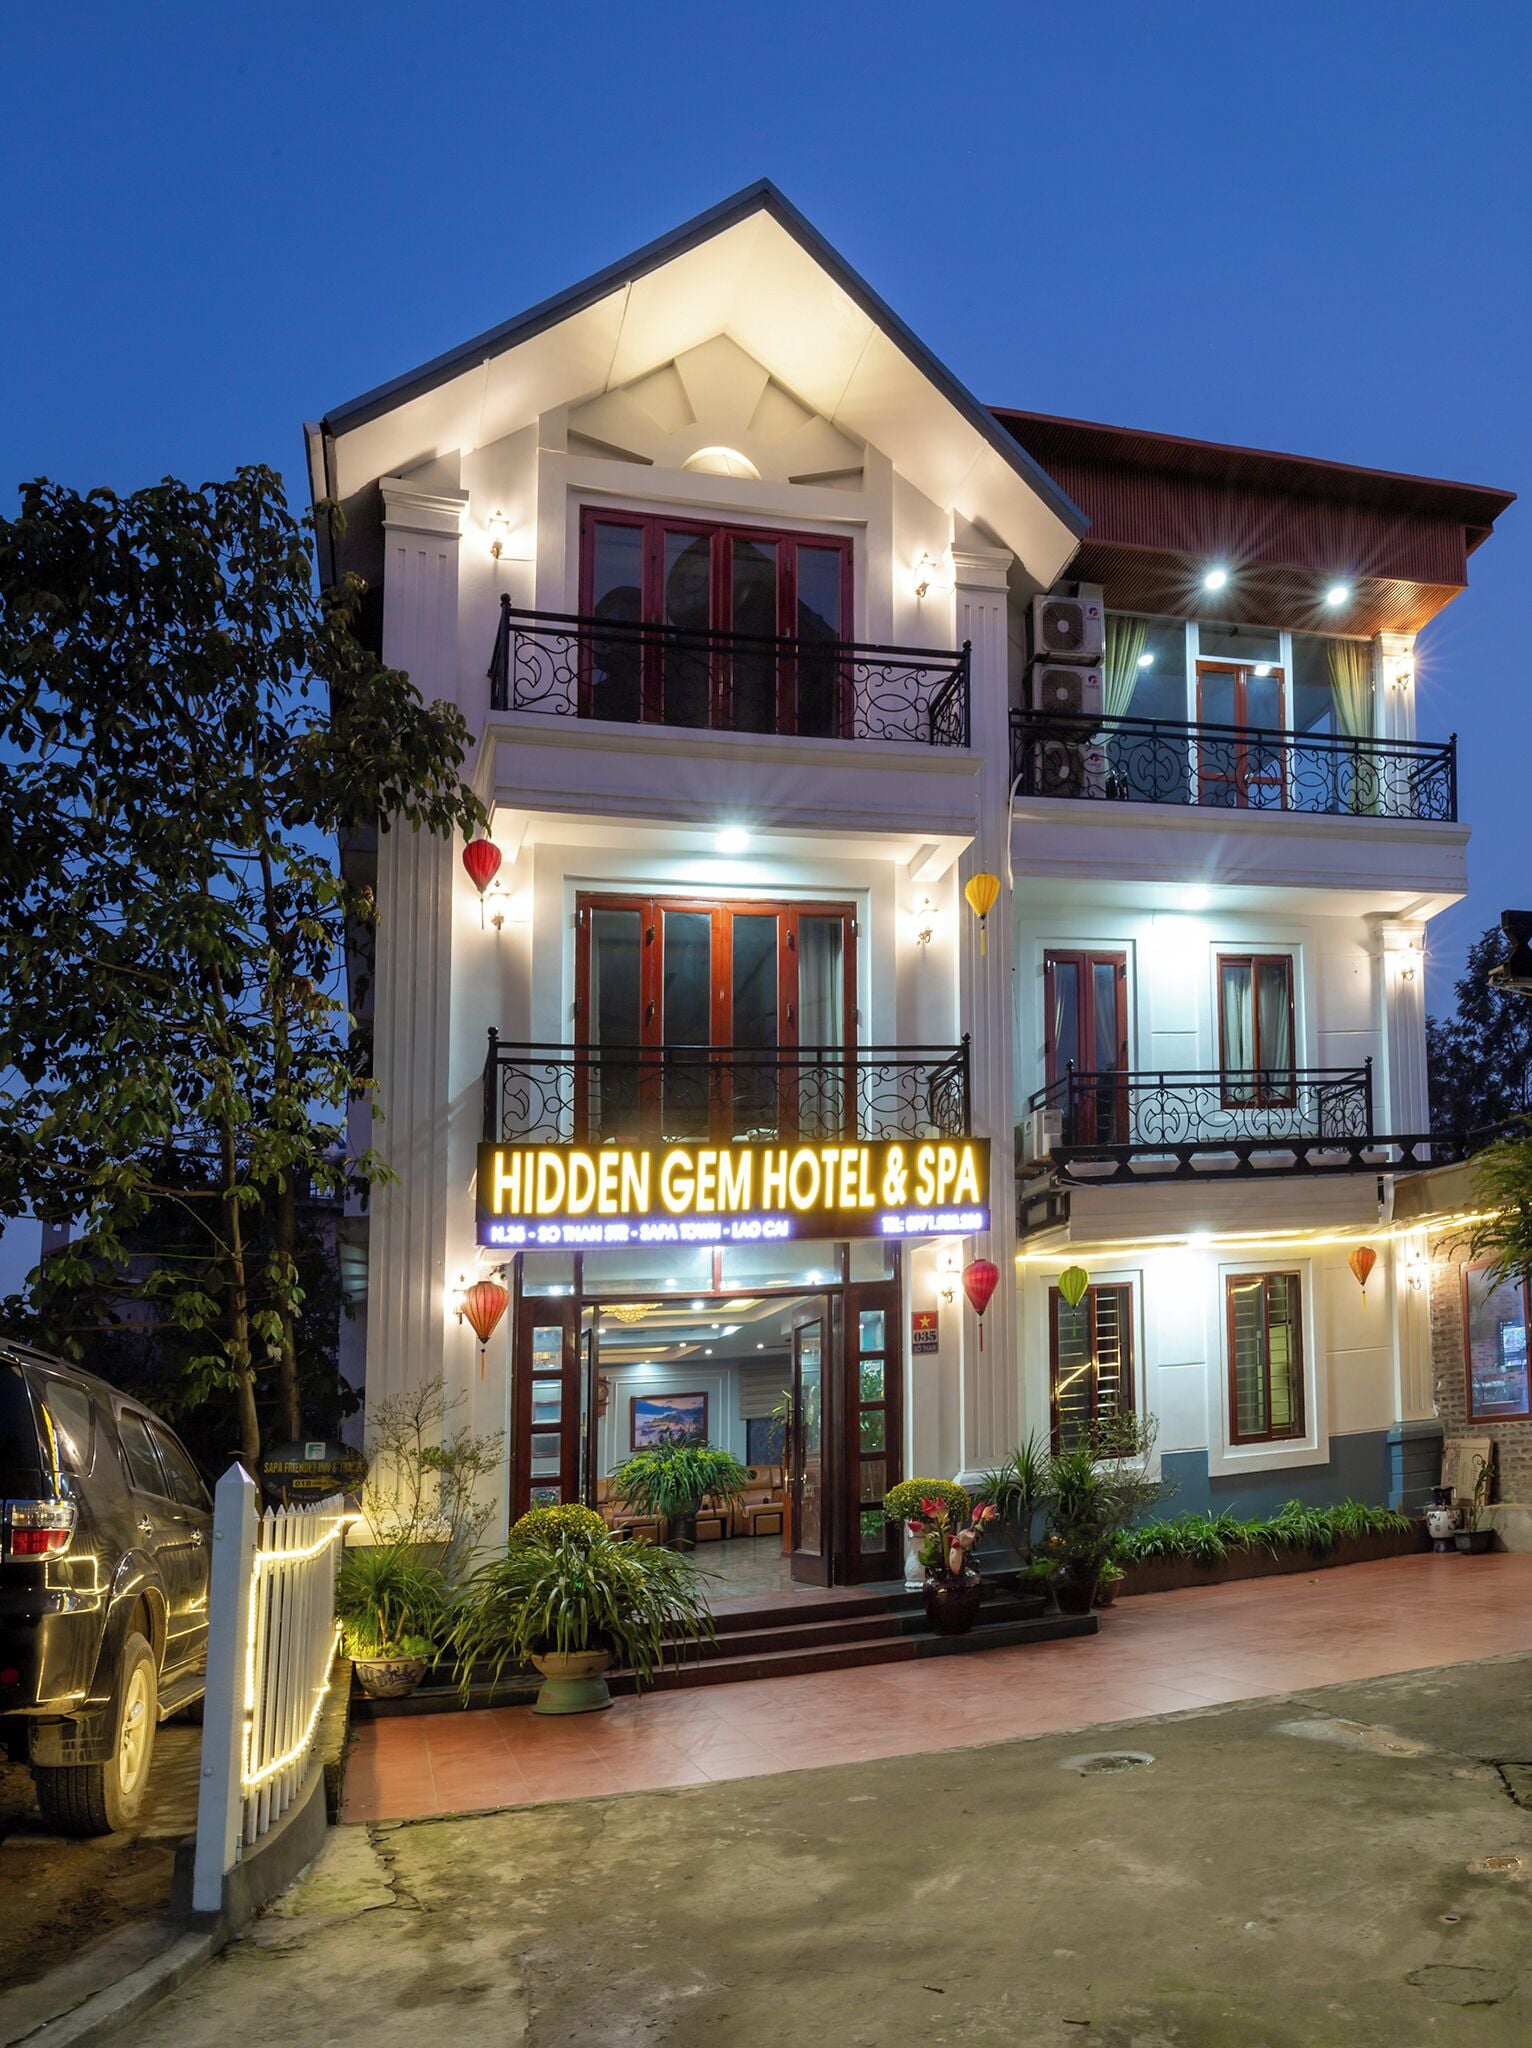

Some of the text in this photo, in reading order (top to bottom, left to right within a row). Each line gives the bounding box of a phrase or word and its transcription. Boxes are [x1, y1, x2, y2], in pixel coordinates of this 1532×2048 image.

[492, 1145, 981, 1214] HIDDEN GEM HOTEL & SPA
[639, 1223, 678, 1241] SAPA
[679, 1222, 721, 1240] TOWN
[732, 1221, 762, 1239] LAO
[762, 1220, 789, 1238] CAI
[914, 1331, 936, 1342] 035
[264, 1462, 283, 1473] SAPA
